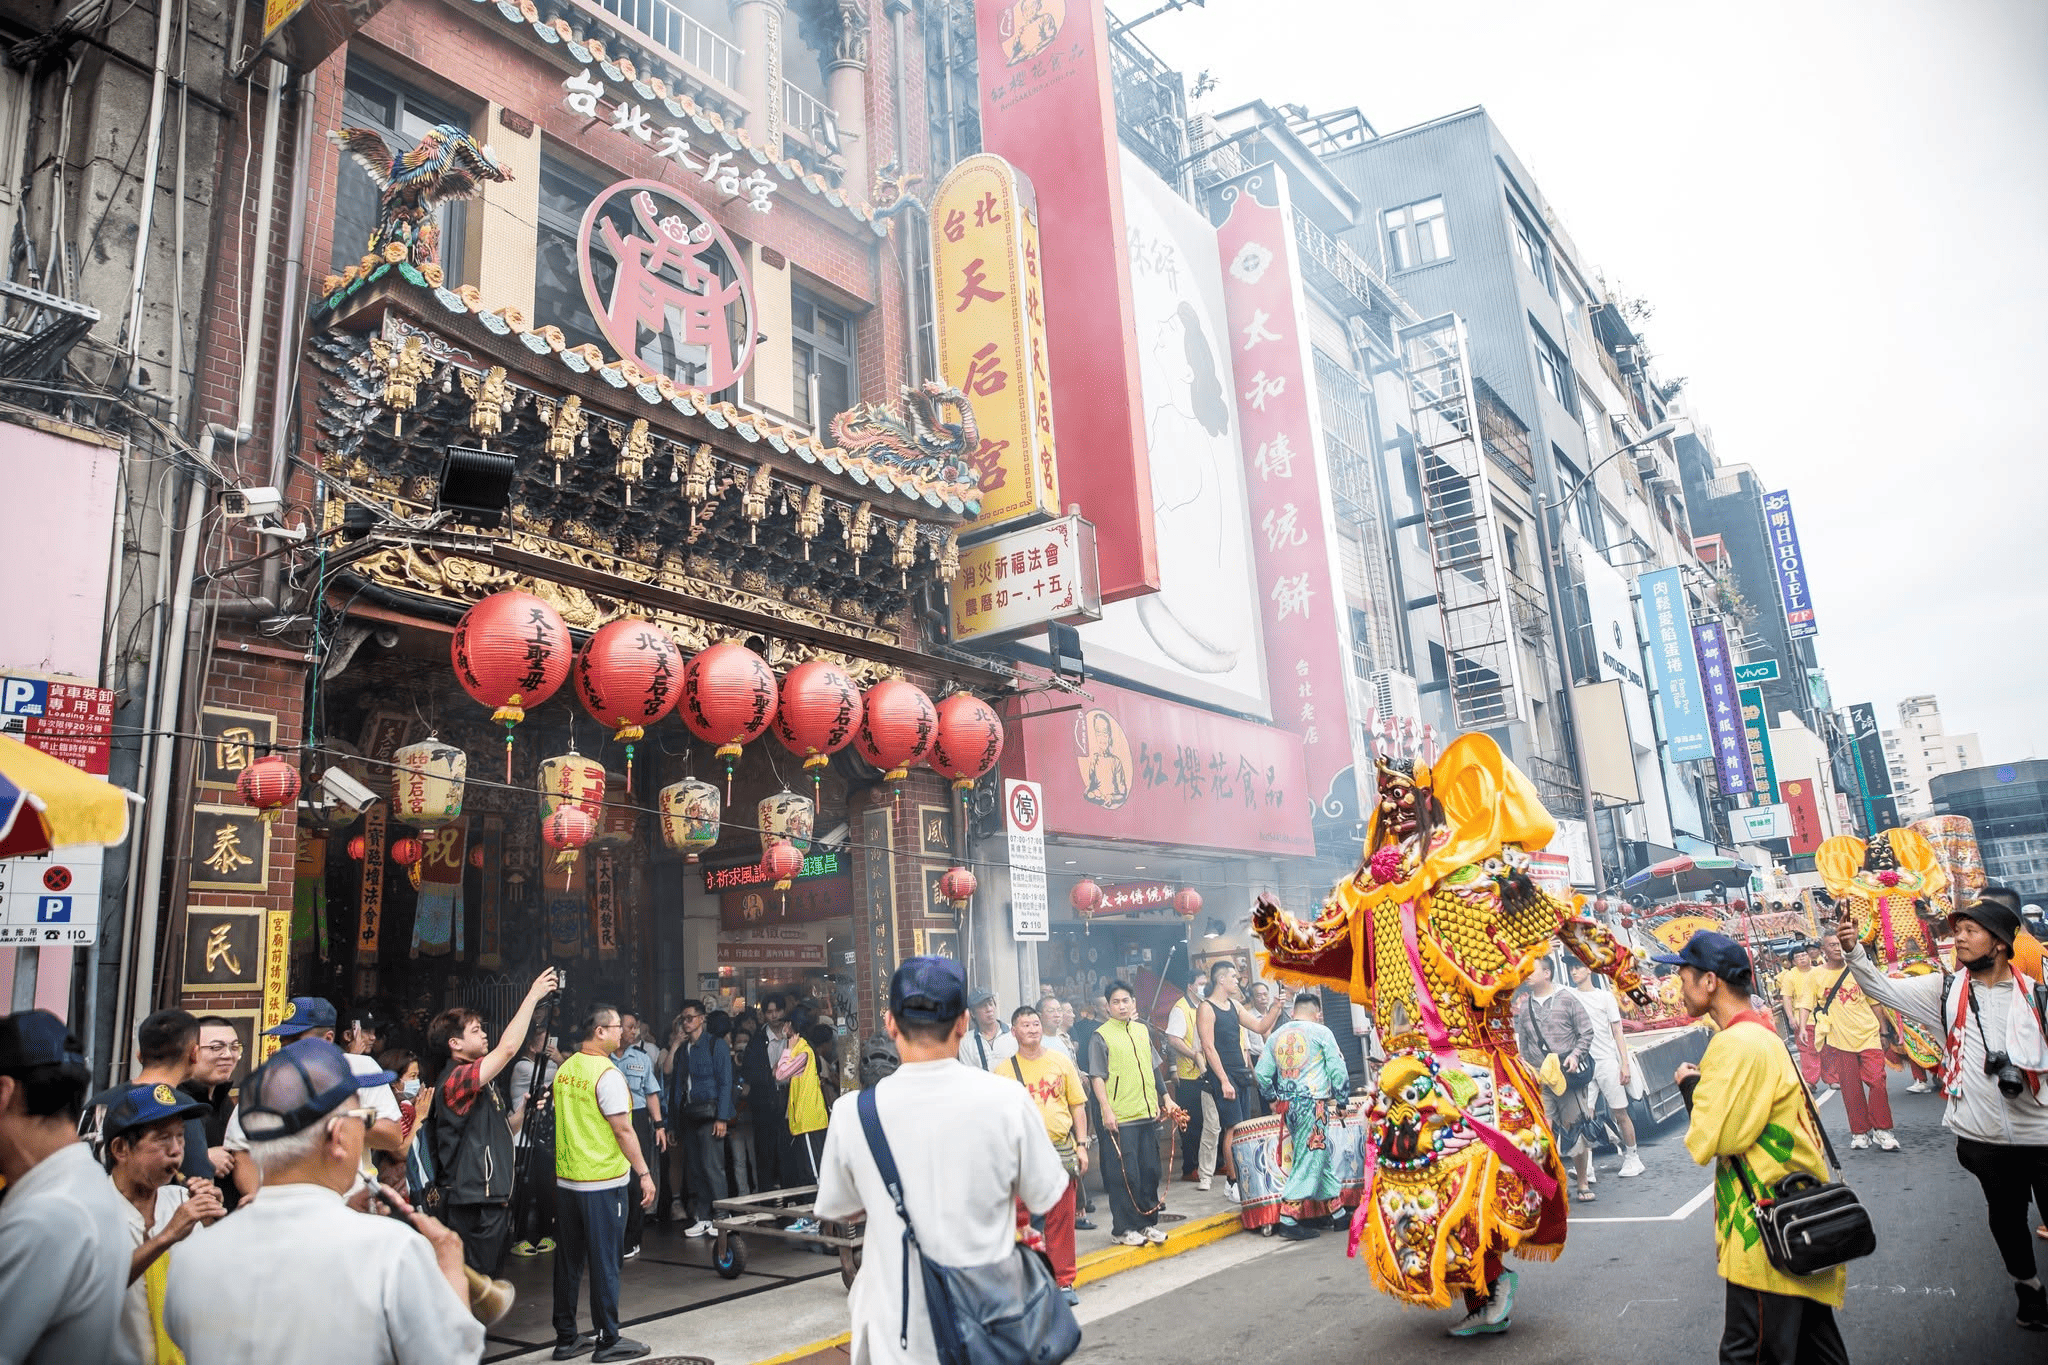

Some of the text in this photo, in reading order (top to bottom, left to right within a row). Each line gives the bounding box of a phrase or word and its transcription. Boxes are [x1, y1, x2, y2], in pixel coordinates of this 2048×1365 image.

[561, 68, 777, 213] 台北天后宮
[943, 191, 1002, 243] 台北
[956, 258, 1010, 495] 天后宮
[1025, 239, 1053, 490] 台北天后宮
[963, 543, 1059, 590] 消災祈福法會
[1778, 544, 1806, 609] HOTEL
[1737, 668, 1769, 679] vivo
[49, 698, 112, 715] 專用區
[50, 684, 113, 703] 貨車裝卸
[48, 711, 84, 720] Loading
[1015, 793, 1034, 823] 停
[204, 824, 253, 874] 泰
[46, 899, 63, 919] P
[1030, 921, 1041, 929] 110
[67, 930, 86, 940] 110
[206, 923, 241, 976] 民
